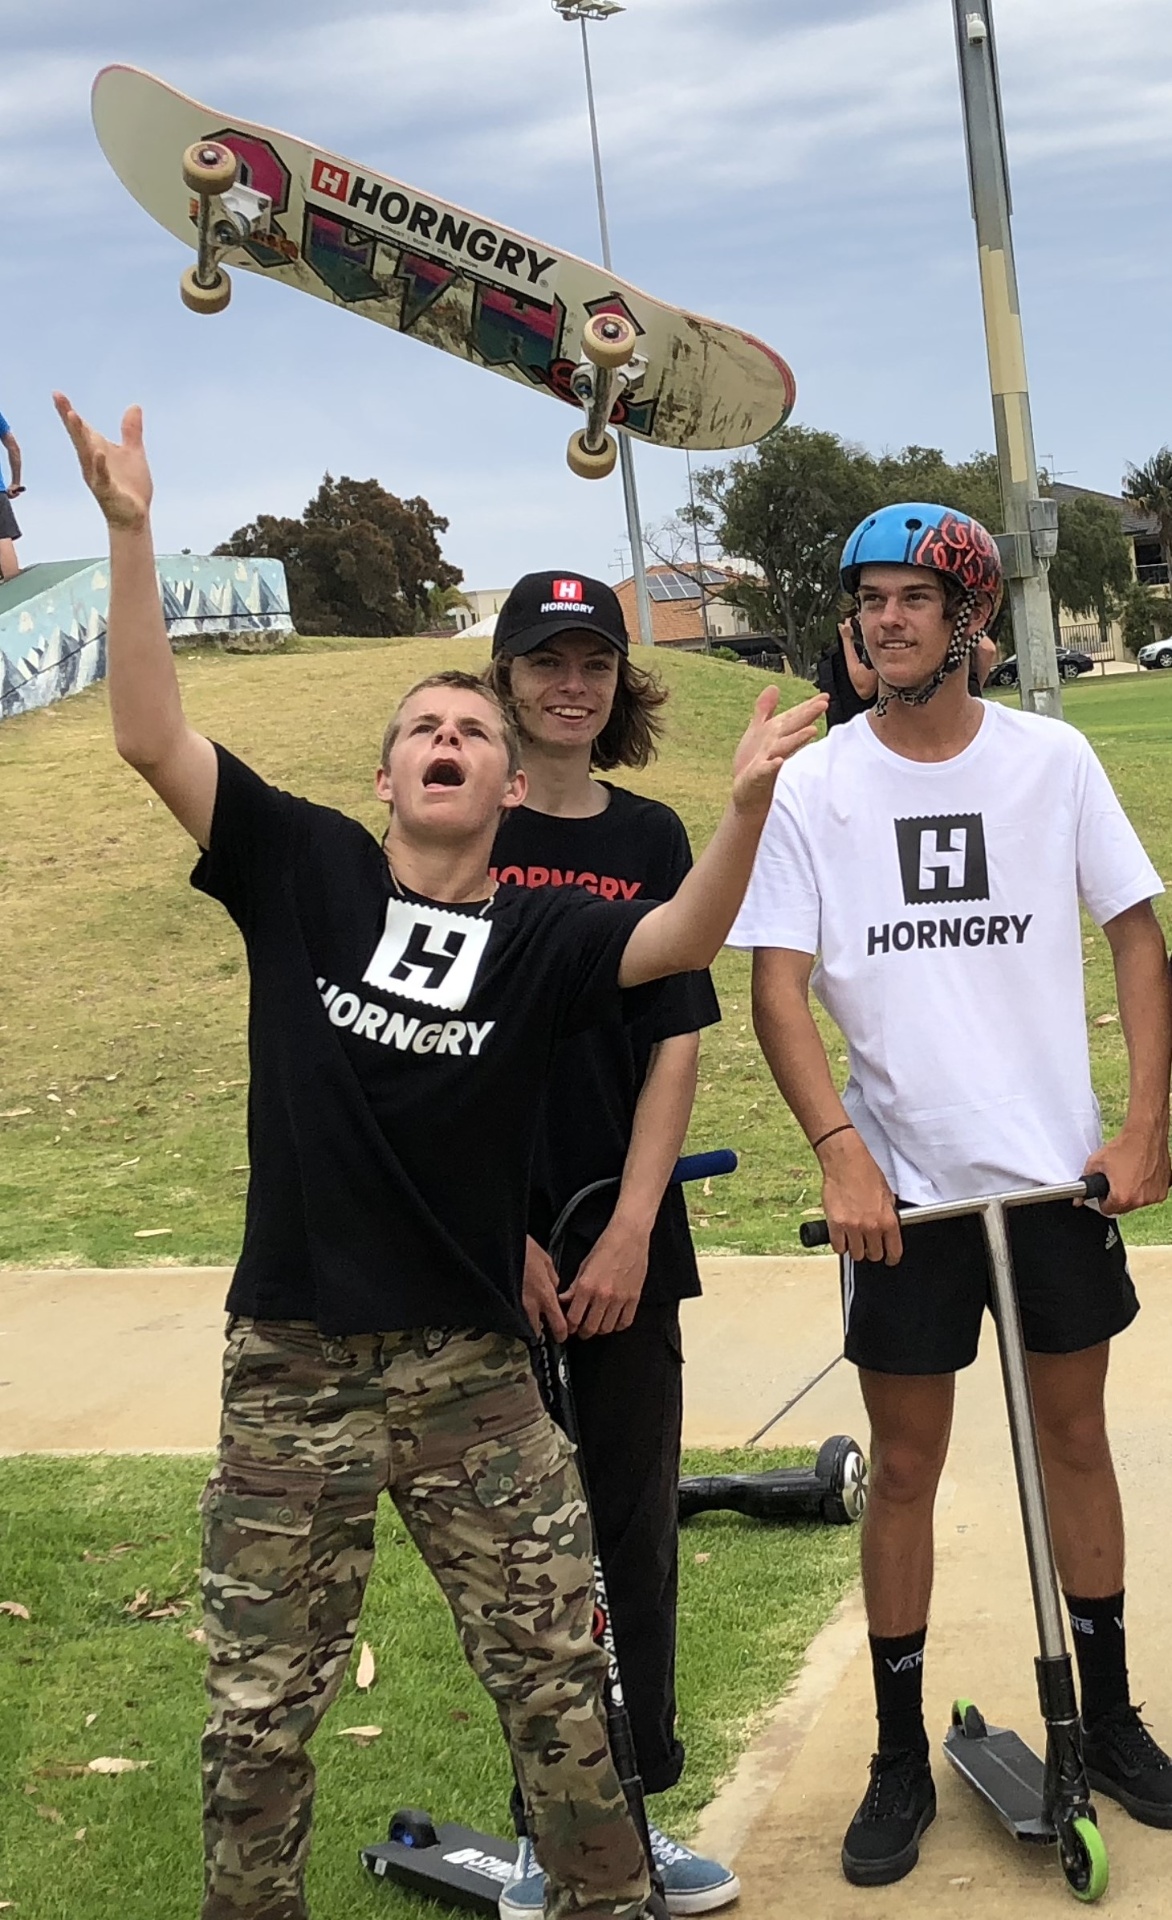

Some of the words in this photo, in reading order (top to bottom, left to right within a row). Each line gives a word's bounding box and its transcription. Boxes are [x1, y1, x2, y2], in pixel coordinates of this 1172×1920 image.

[347, 176, 557, 284] HORNGRY
[540, 602, 595, 614] HORNGRY
[867, 914, 1034, 956] HORNGRY
[885, 1649, 925, 1673] VAN
